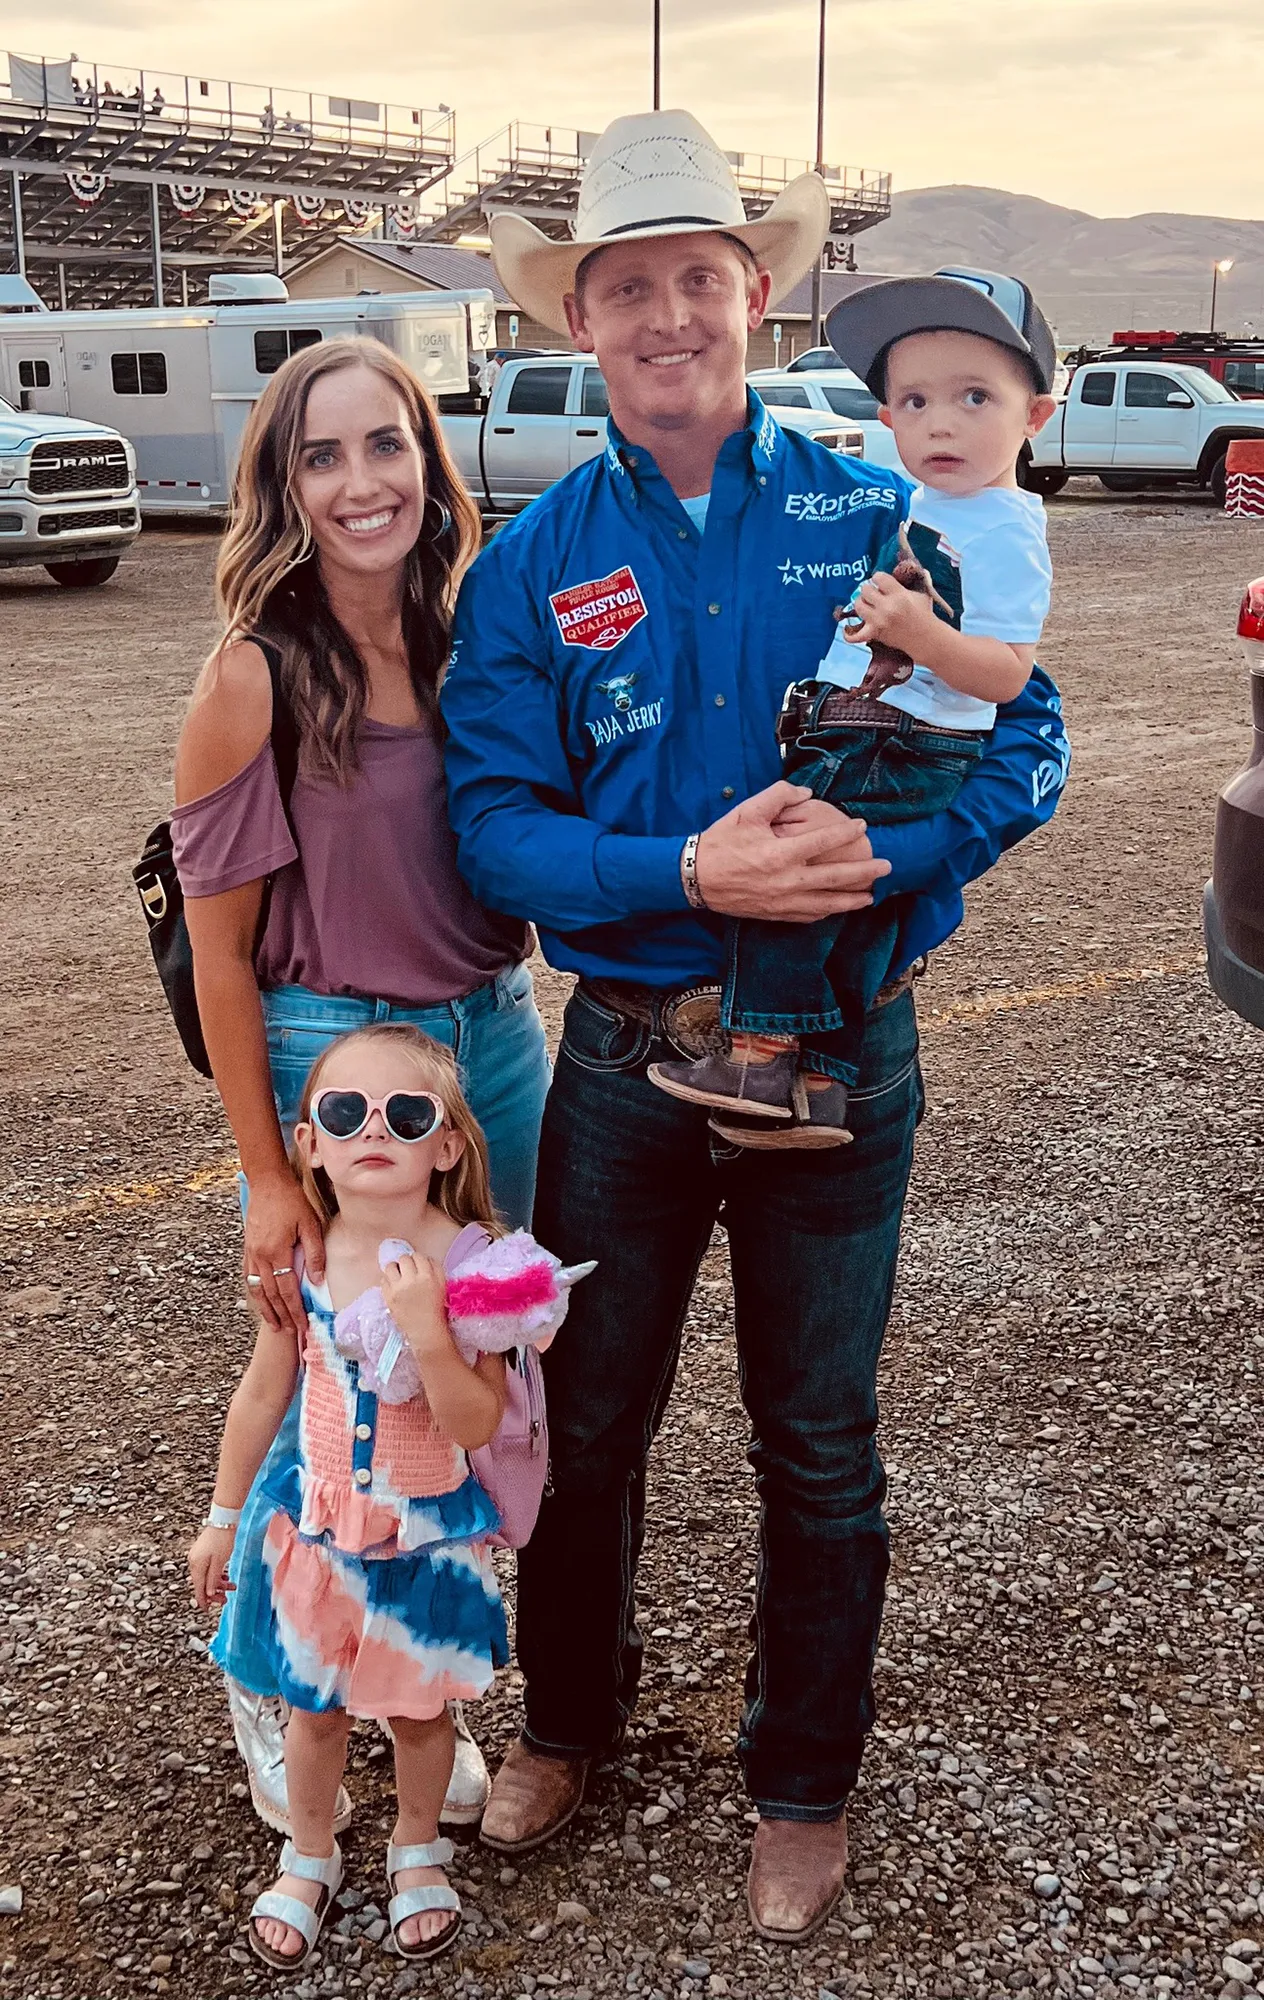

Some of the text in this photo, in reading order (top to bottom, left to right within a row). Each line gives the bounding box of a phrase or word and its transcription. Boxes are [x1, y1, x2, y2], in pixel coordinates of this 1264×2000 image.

[63, 456, 104, 467] RAM
[805, 500, 895, 522] EMPLOYMENT PROFESSIONALS
[806, 555, 871, 581] Wrangl
[558, 587, 639, 630] RESISTOL
[566, 604, 643, 640] QUALIFIER
[585, 701, 661, 747] BAJA JERKY
